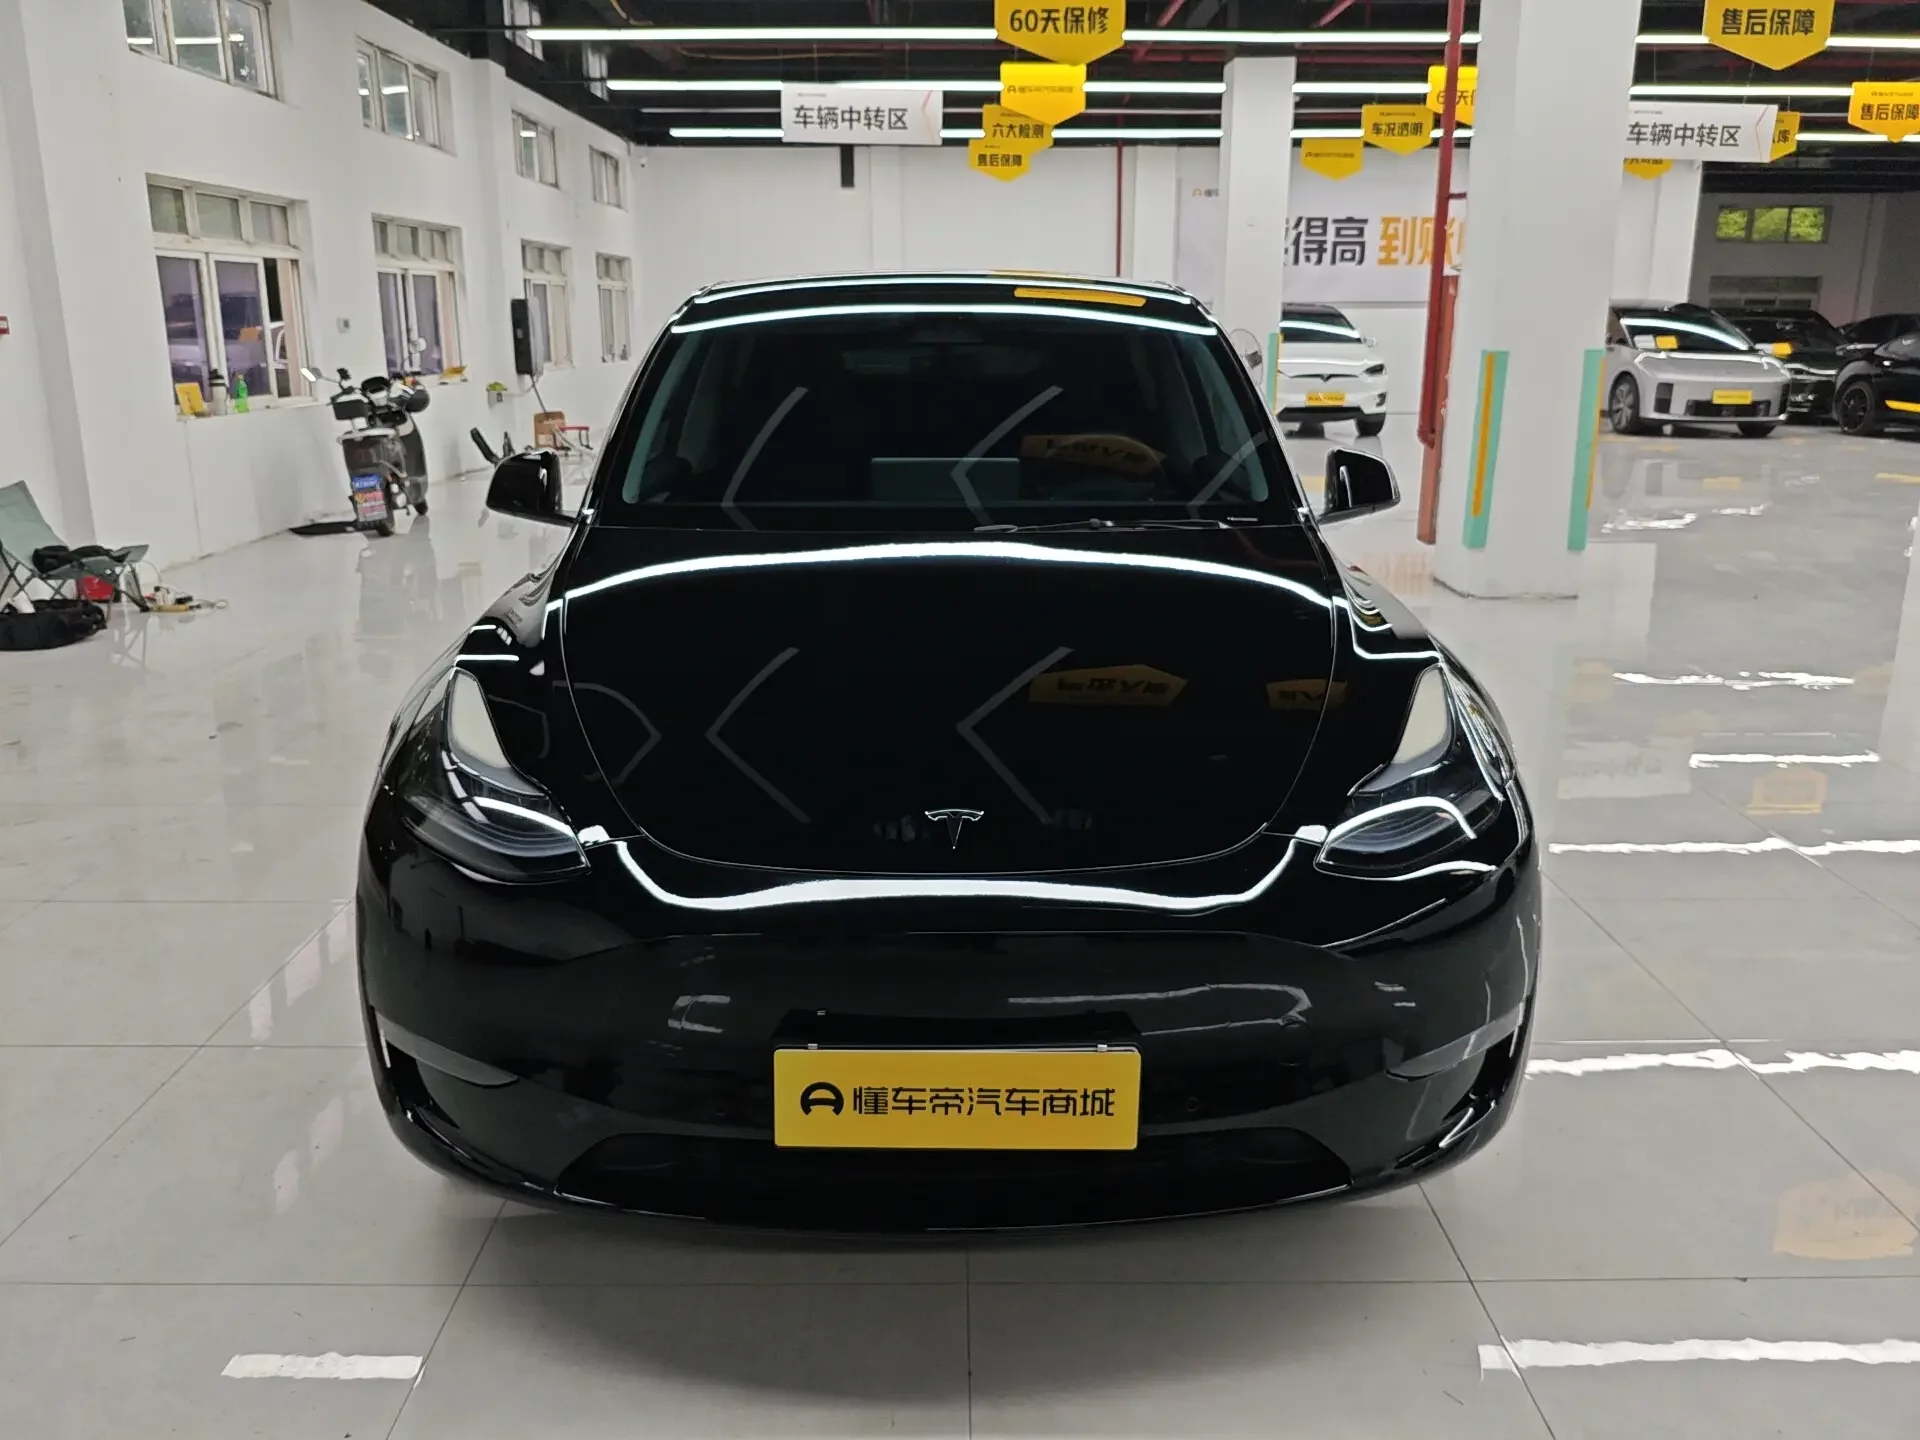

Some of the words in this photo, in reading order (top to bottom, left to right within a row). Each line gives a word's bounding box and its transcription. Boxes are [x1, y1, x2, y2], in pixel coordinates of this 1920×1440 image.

[1010, 6, 1109, 35] 60天保修
[1721, 8, 1816, 36] 售后保障
[793, 105, 909, 131] 车辆中转区
[1860, 102, 1919, 120] 售后保障
[992, 123, 1045, 139] 六大检测
[1626, 121, 1742, 147] 车辆中转区
[1283, 215, 1369, 266] 得高
[1377, 215, 1464, 266] 到账
[852, 1086, 1116, 1117] 懂车帝汽车商城
